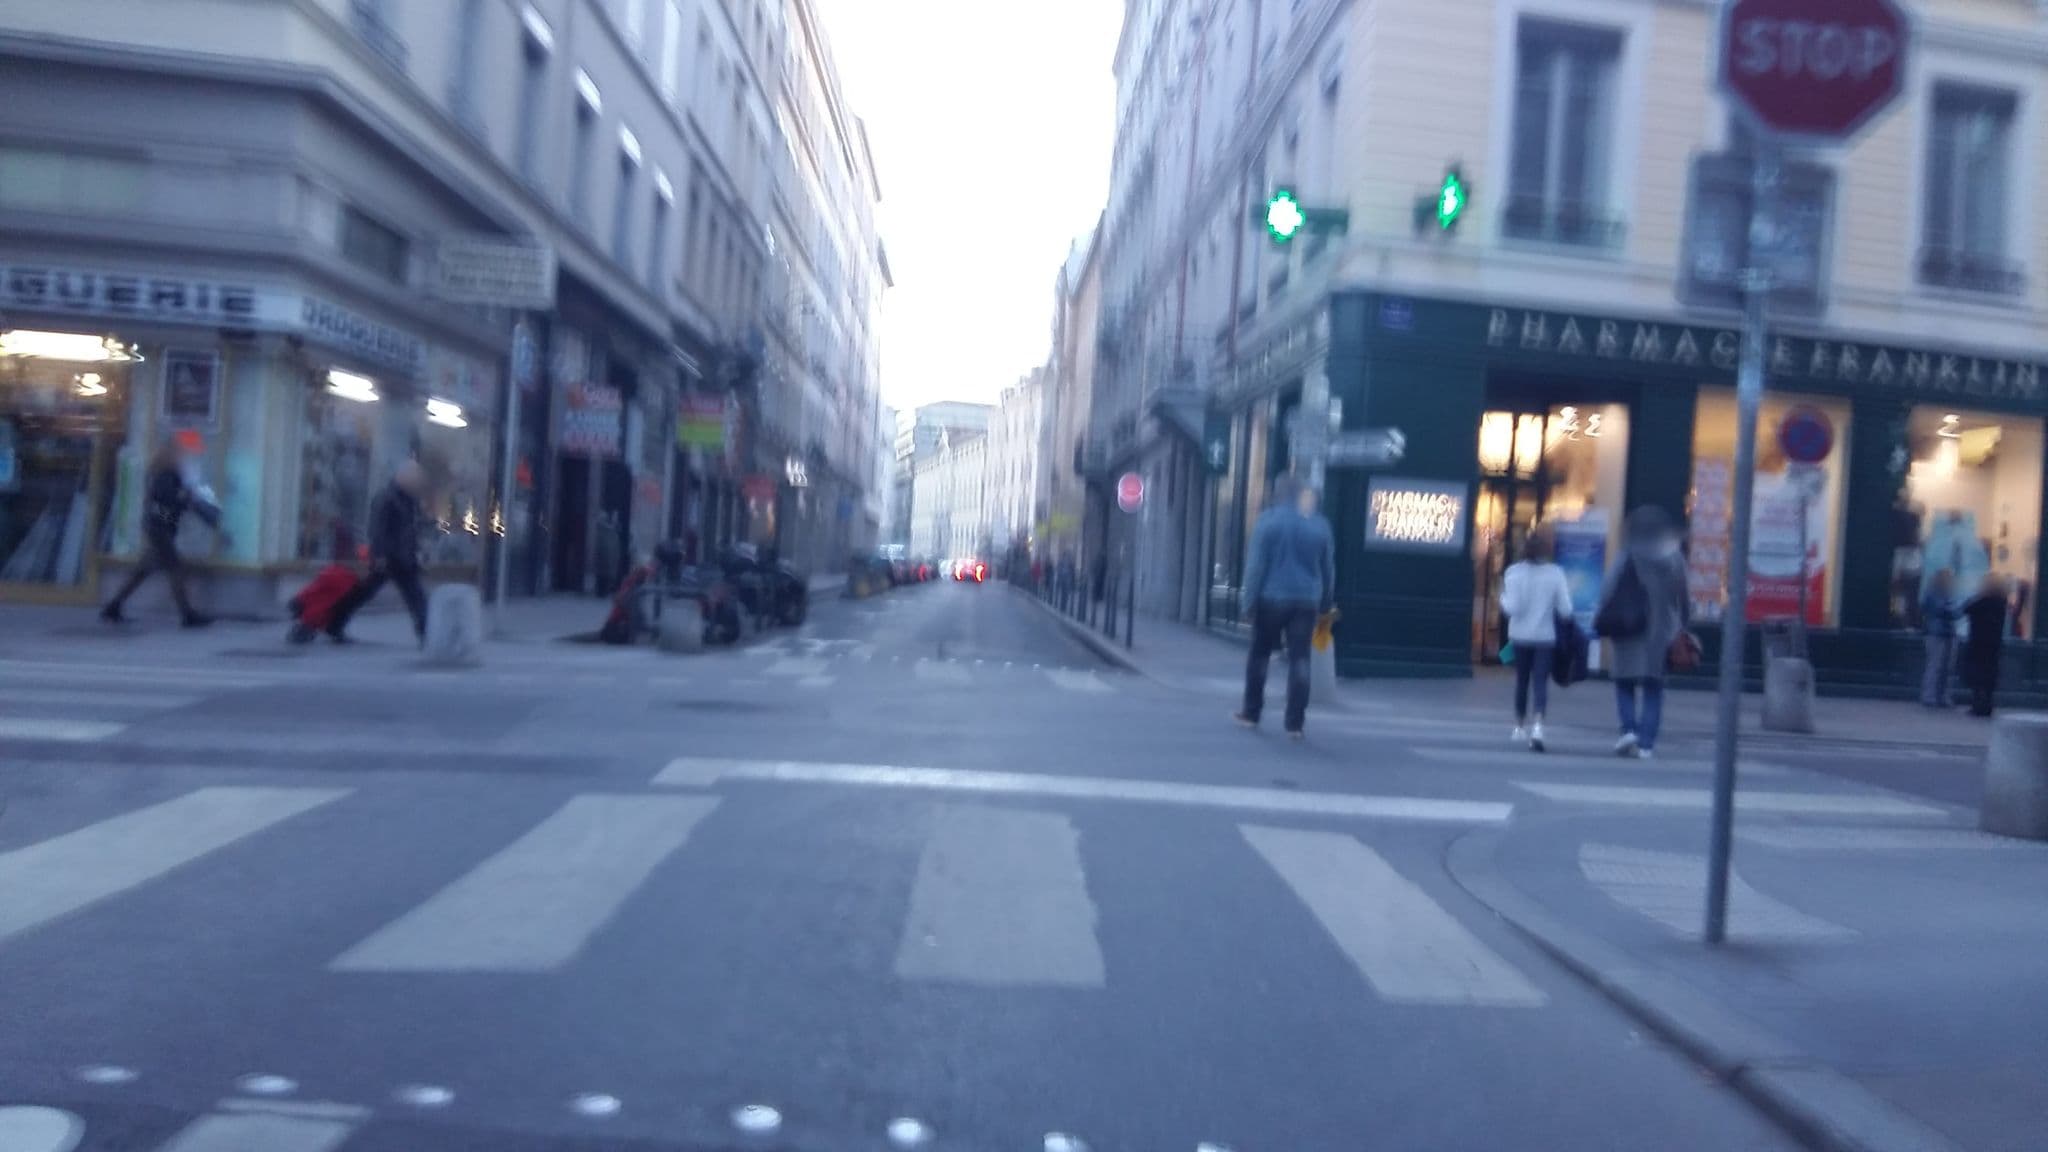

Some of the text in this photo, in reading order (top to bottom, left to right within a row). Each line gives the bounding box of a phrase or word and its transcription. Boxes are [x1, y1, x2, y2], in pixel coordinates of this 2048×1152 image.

[1738, 19, 1893, 81] STOP
[1487, 308, 2040, 400] PHARMACE FRANKLIN
